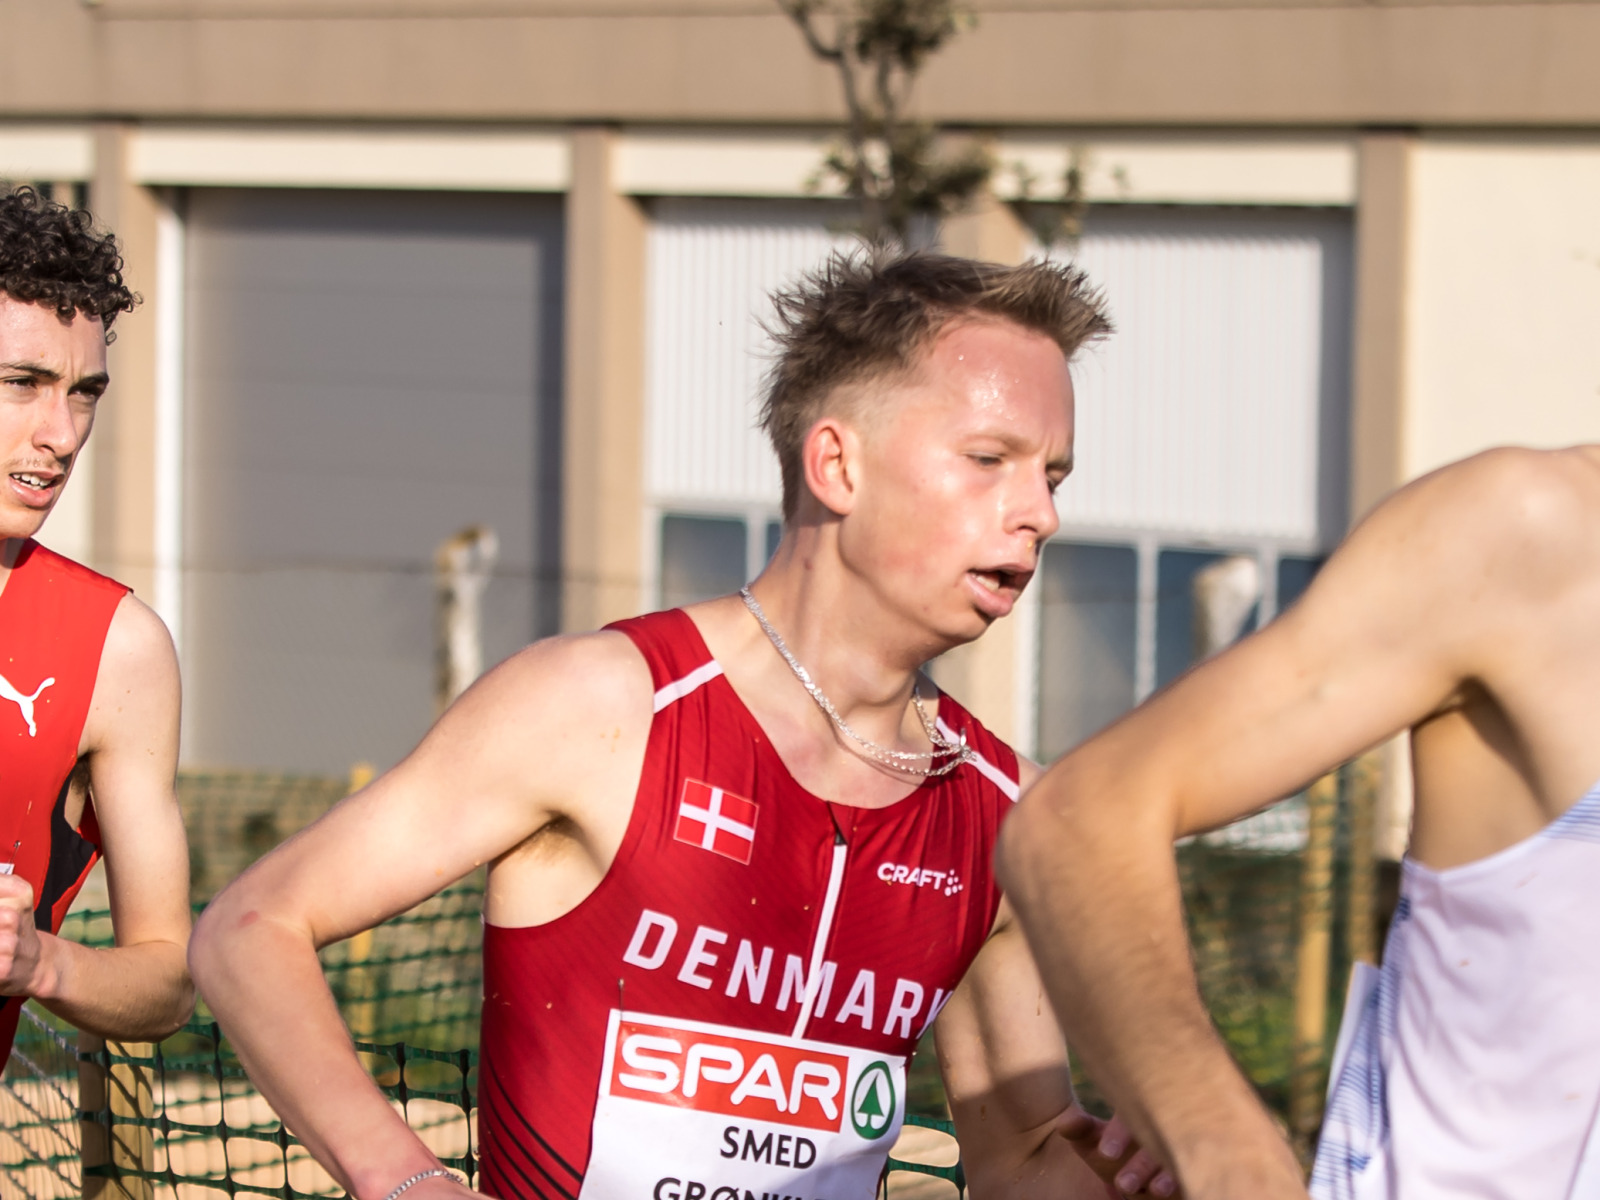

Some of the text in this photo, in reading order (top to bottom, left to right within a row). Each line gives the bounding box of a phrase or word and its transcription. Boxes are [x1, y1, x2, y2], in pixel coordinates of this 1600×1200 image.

[877, 862, 946, 890] CRAFT
[622, 908, 953, 1040] DENMARK
[618, 1033, 841, 1120] SPAR
[720, 1126, 816, 1169] SMED
